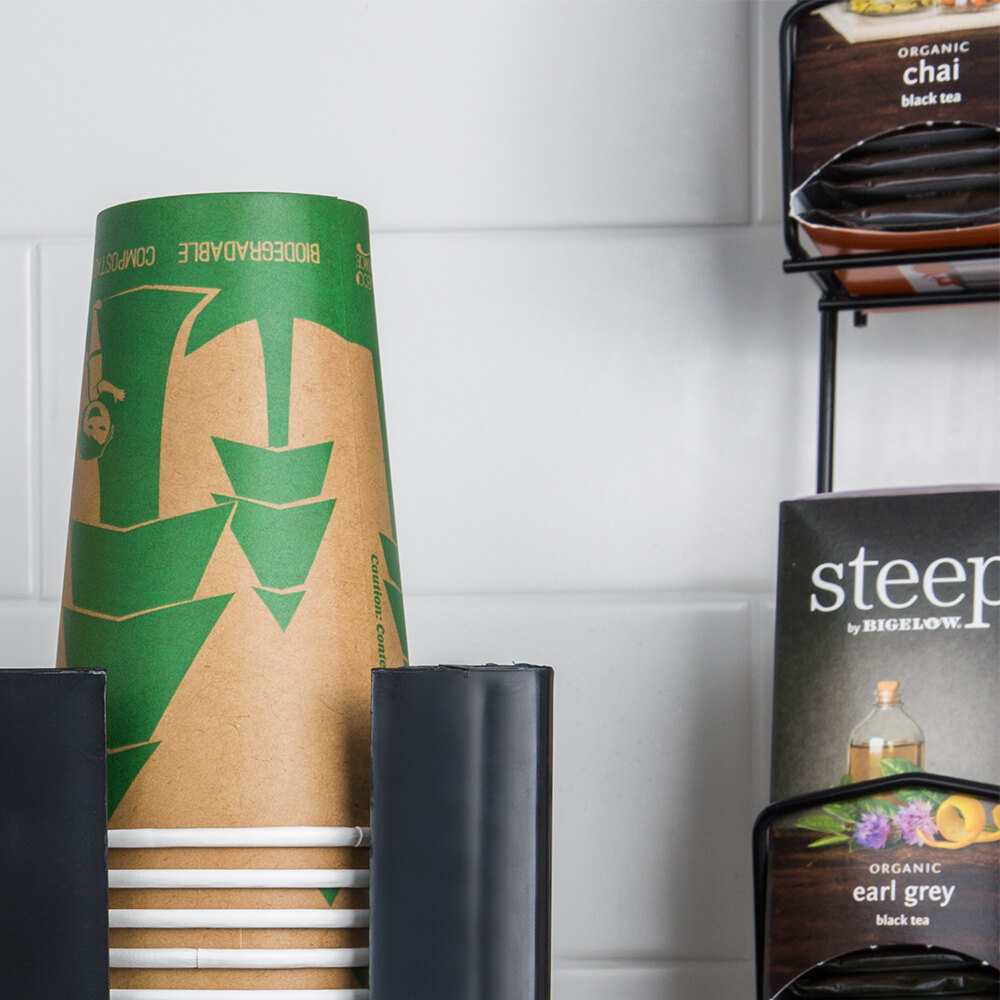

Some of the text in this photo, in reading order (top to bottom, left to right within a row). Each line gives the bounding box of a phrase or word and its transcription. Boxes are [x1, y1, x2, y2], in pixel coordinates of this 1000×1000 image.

[898, 41, 970, 58] ORGANIC
[903, 57, 960, 85] chai
[901, 91, 962, 108] black tea
[178, 241, 320, 264] BIODEGRADABLE
[370, 554, 384, 622] Caution:
[847, 622, 861, 635] by
[869, 863, 942, 875] ORGANIC
[853, 879, 956, 907] earl grey
[876, 914, 930, 926] black tea
